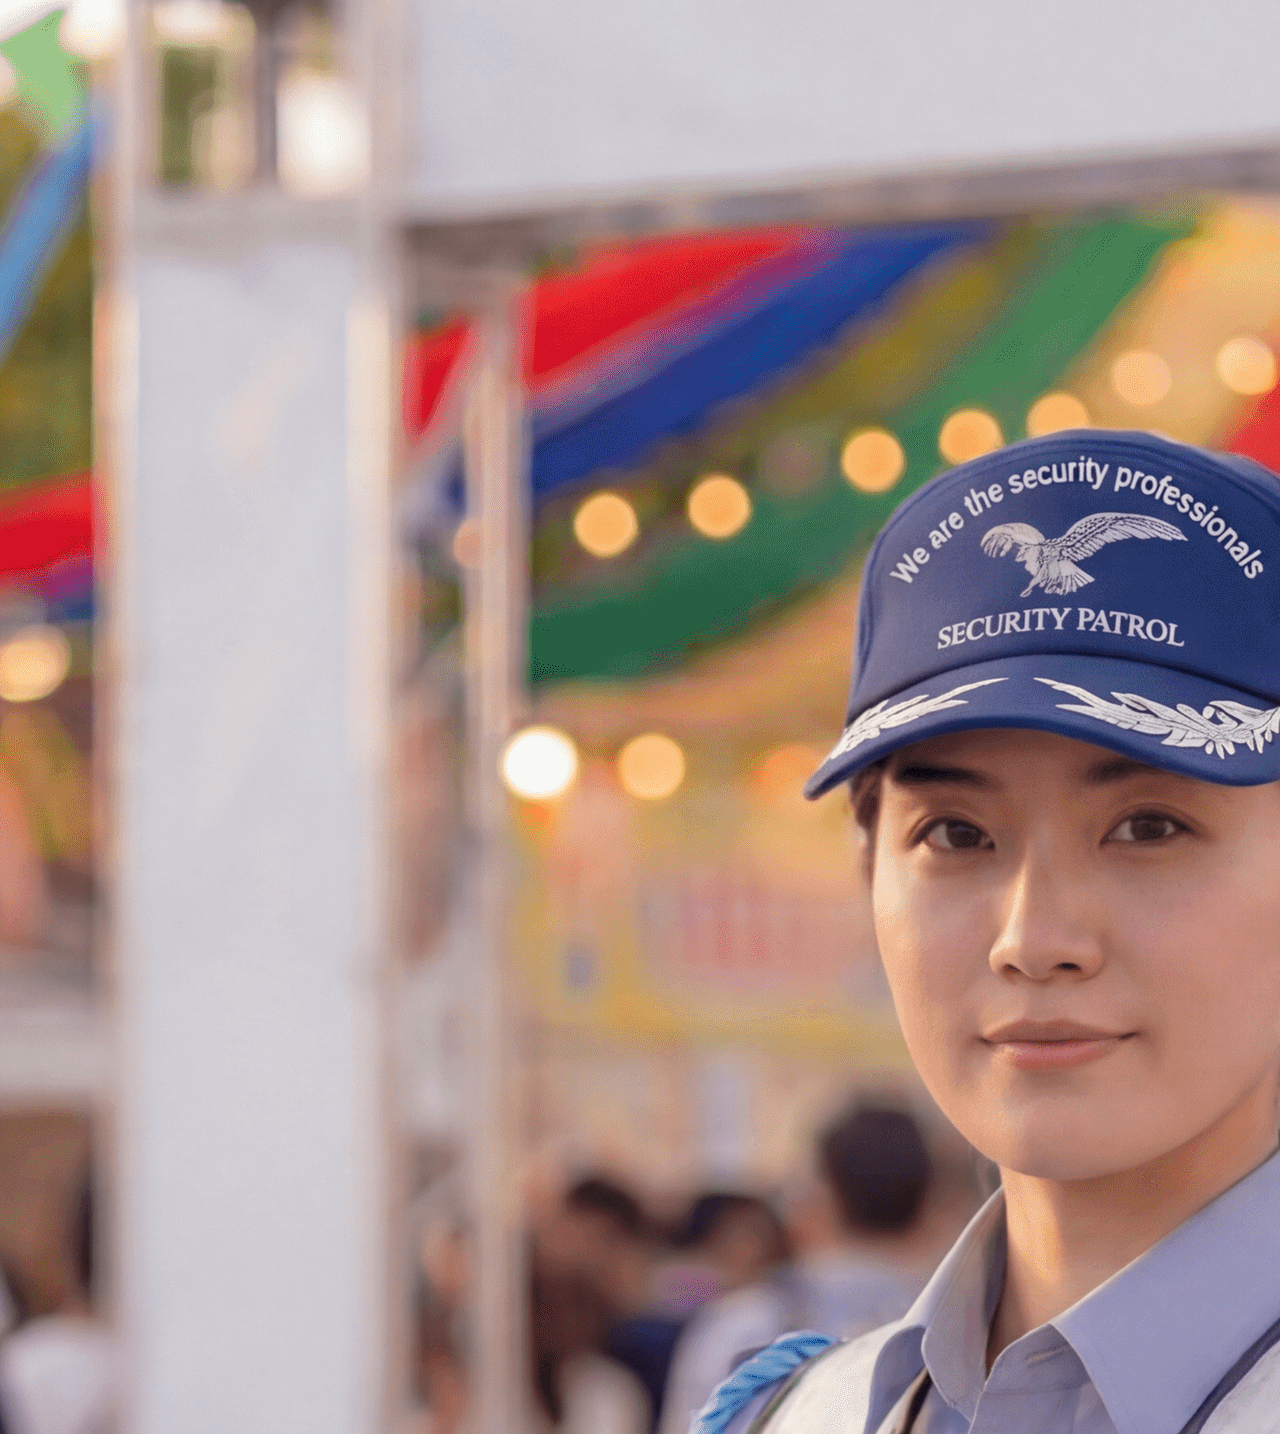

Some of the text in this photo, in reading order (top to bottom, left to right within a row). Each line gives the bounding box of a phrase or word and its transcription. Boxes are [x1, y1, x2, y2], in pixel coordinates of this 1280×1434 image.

[889, 455, 1264, 585] We are the security professionals
[936, 607, 1185, 650] SECURITY PATROL
